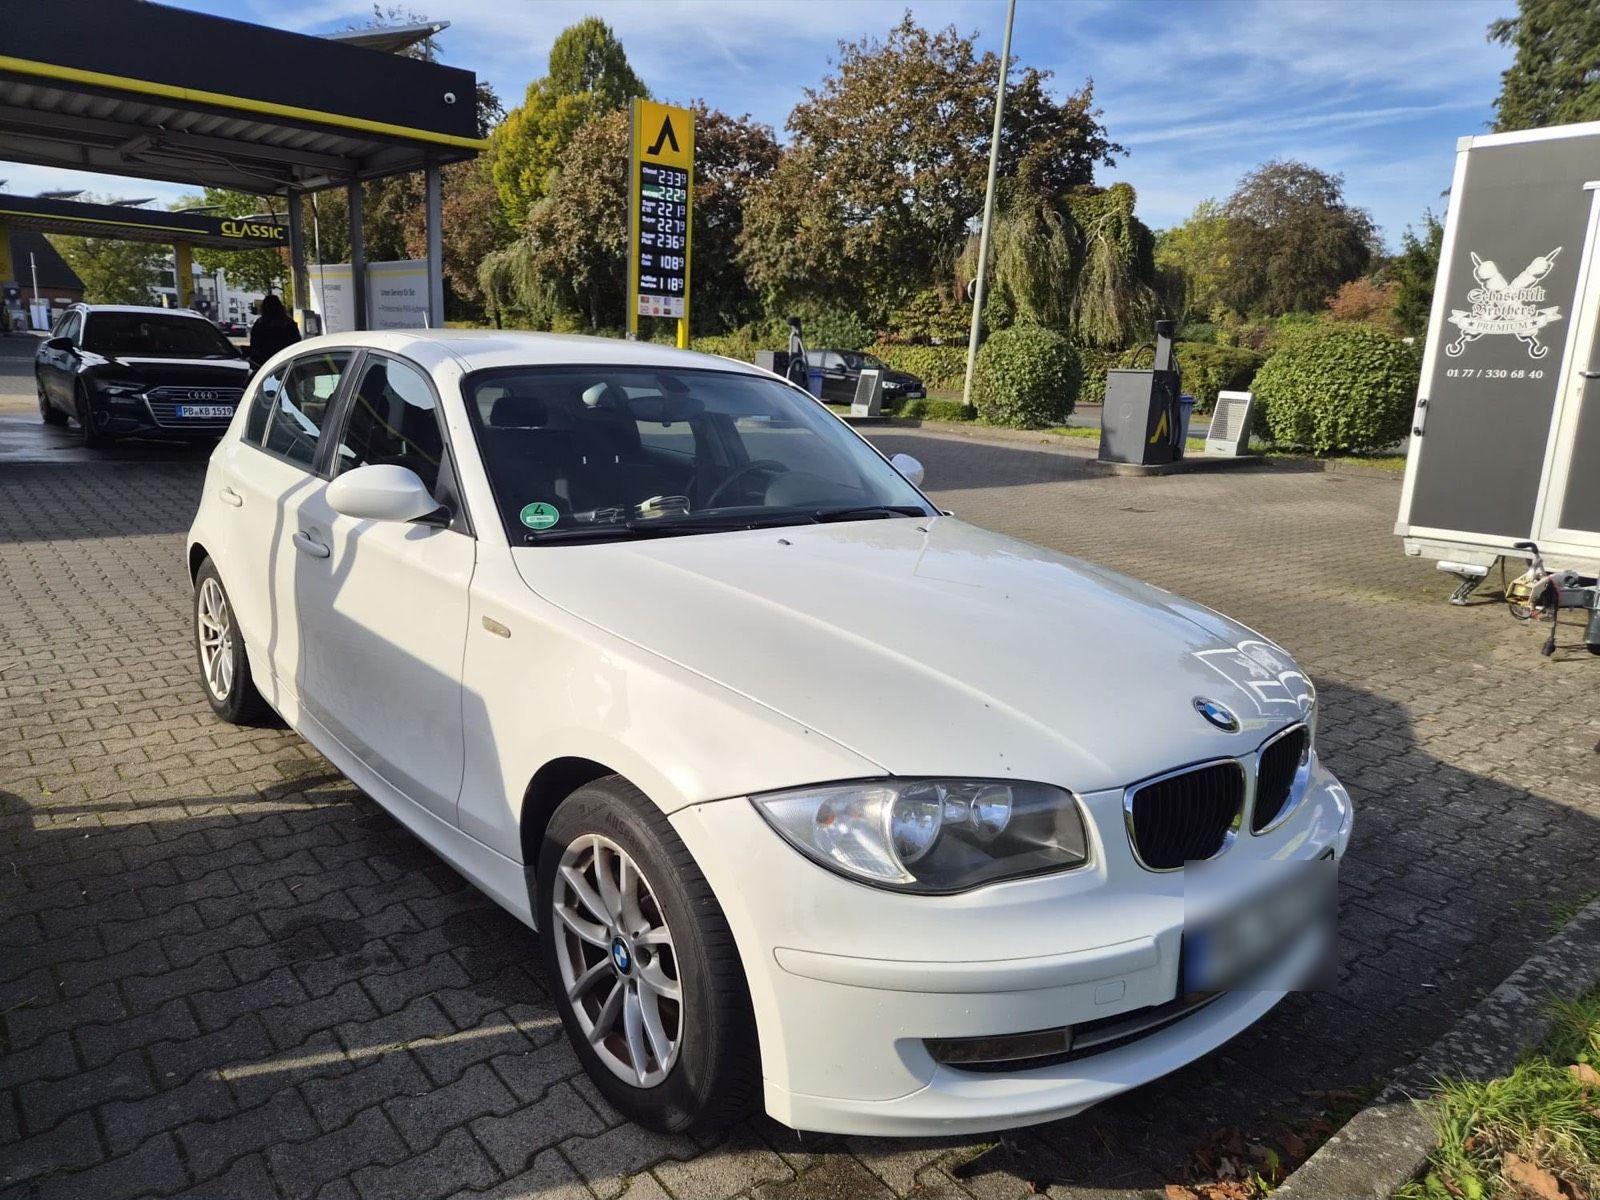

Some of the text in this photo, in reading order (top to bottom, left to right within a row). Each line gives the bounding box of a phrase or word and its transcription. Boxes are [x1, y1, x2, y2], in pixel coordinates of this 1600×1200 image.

[659, 170, 687, 186] 2339
[659, 186, 686, 202] 2229
[658, 202, 686, 217] 2219
[221, 221, 284, 240] CLASSIC
[658, 218, 686, 233] 2279
[657, 233, 685, 249] 2369
[661, 255, 684, 271] 1089
[660, 277, 684, 291] 1189
[1472, 303, 1537, 317] Brothers
[1476, 321, 1528, 332] PREMIUM
[1485, 369, 1507, 378] 330
[1511, 370, 1524, 379] 68
[1528, 370, 1543, 379] 40
[183, 407, 232, 416] PB KB 1519
[534, 504, 545, 516] 4
